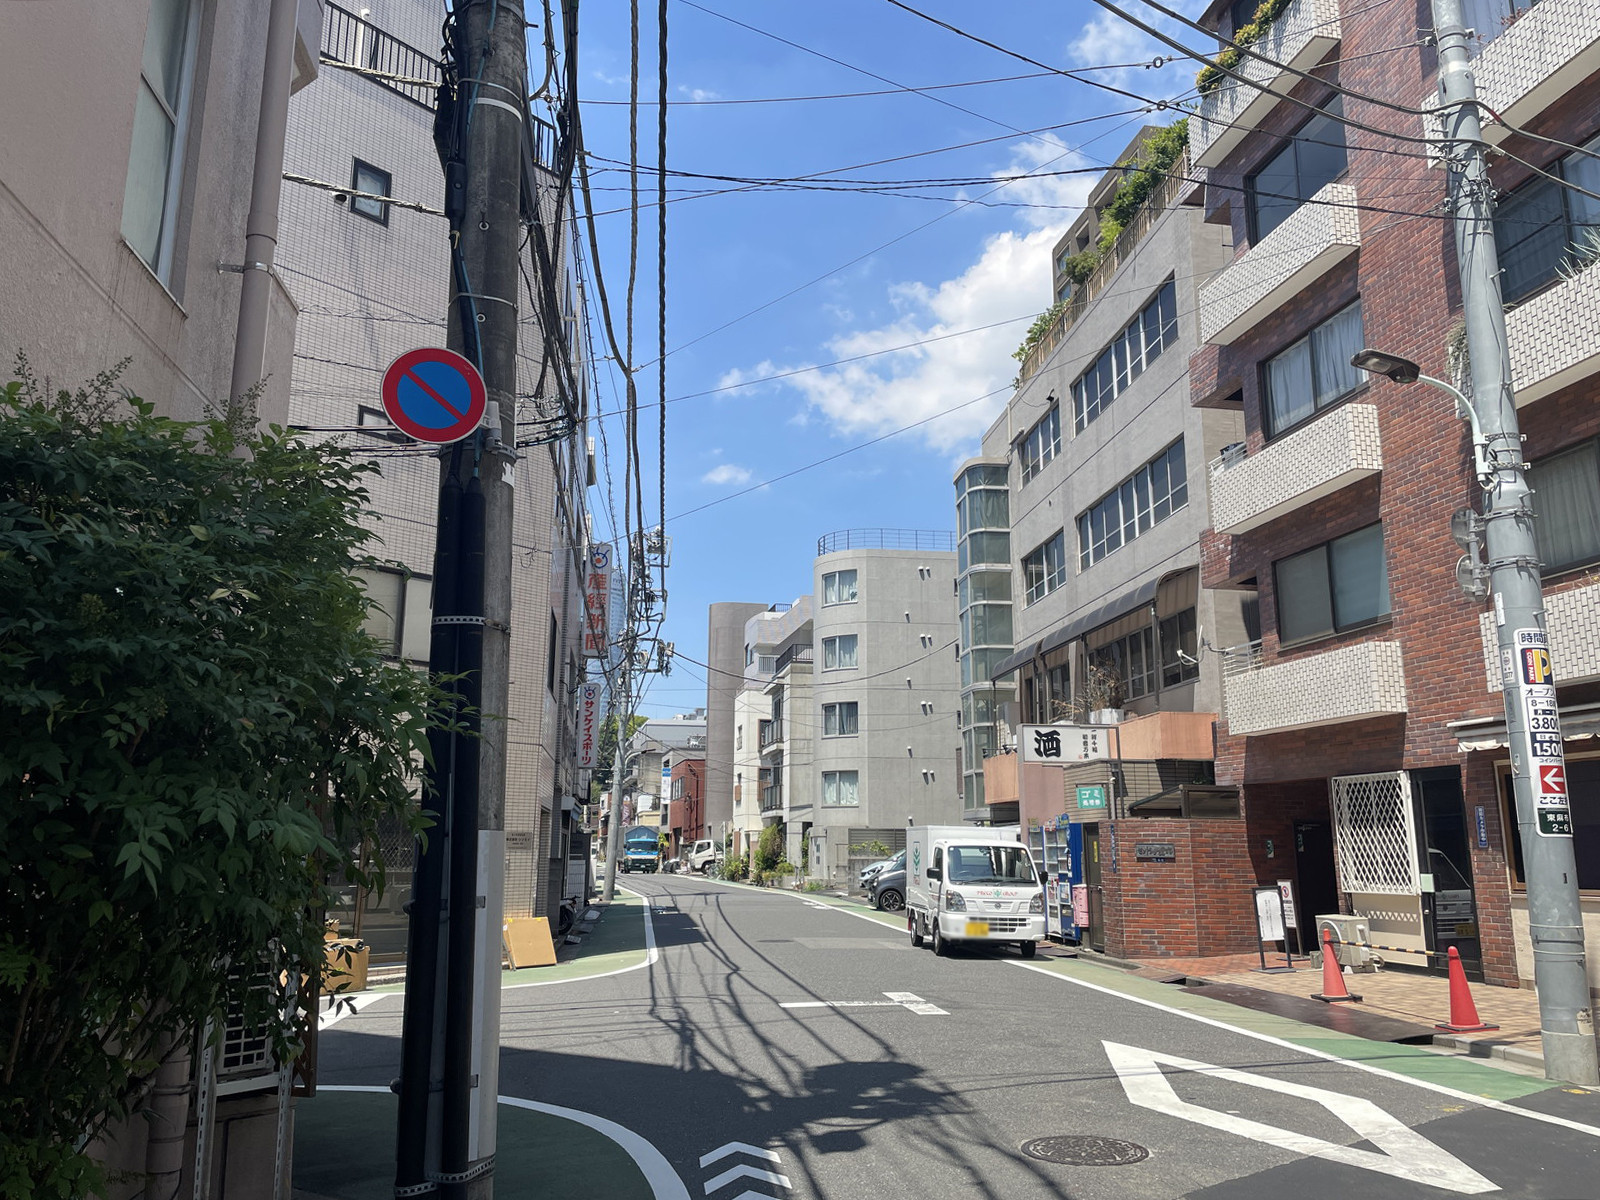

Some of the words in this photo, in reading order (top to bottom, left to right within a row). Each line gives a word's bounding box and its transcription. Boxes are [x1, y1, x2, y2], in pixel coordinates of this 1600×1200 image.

[1527, 666, 1536, 681] PARK
[581, 700, 595, 766] サンケイスポーツ
[1034, 729, 1061, 758] 酒
[1081, 789, 1101, 799] ゴミ
